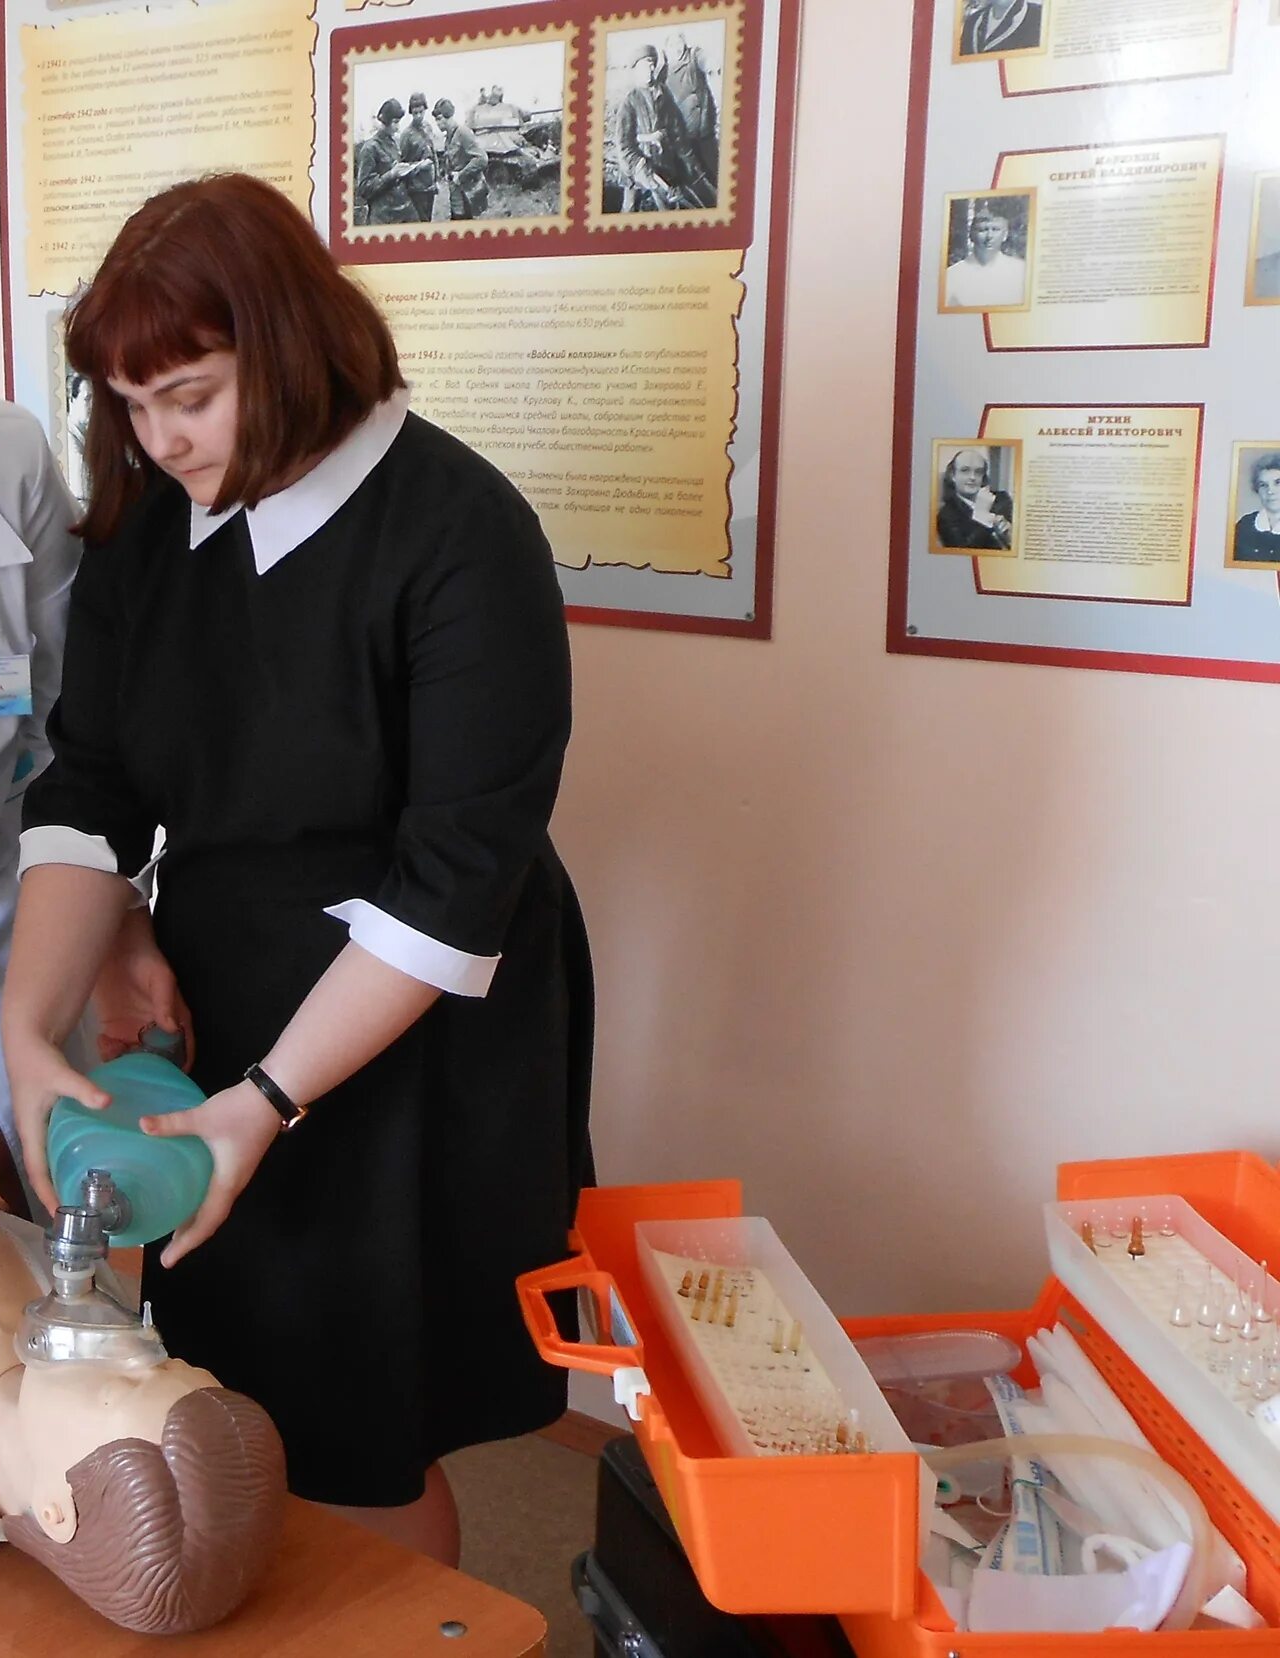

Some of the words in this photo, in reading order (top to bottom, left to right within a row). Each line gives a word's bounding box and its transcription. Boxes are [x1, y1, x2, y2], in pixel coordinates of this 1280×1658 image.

[1049, 168, 1097, 182] СЕРГЕЙ
[420, 291, 440, 301] 1942
[418, 350, 439, 360] 1943
[526, 349, 566, 360] «Вадский
[568, 350, 617, 360] колхозник»
[1087, 415, 1132, 424] МУХИН
[1038, 427, 1093, 437] АЛЕКСЕЙ
[1097, 427, 1183, 437] ВИКТОРОВИЧ
